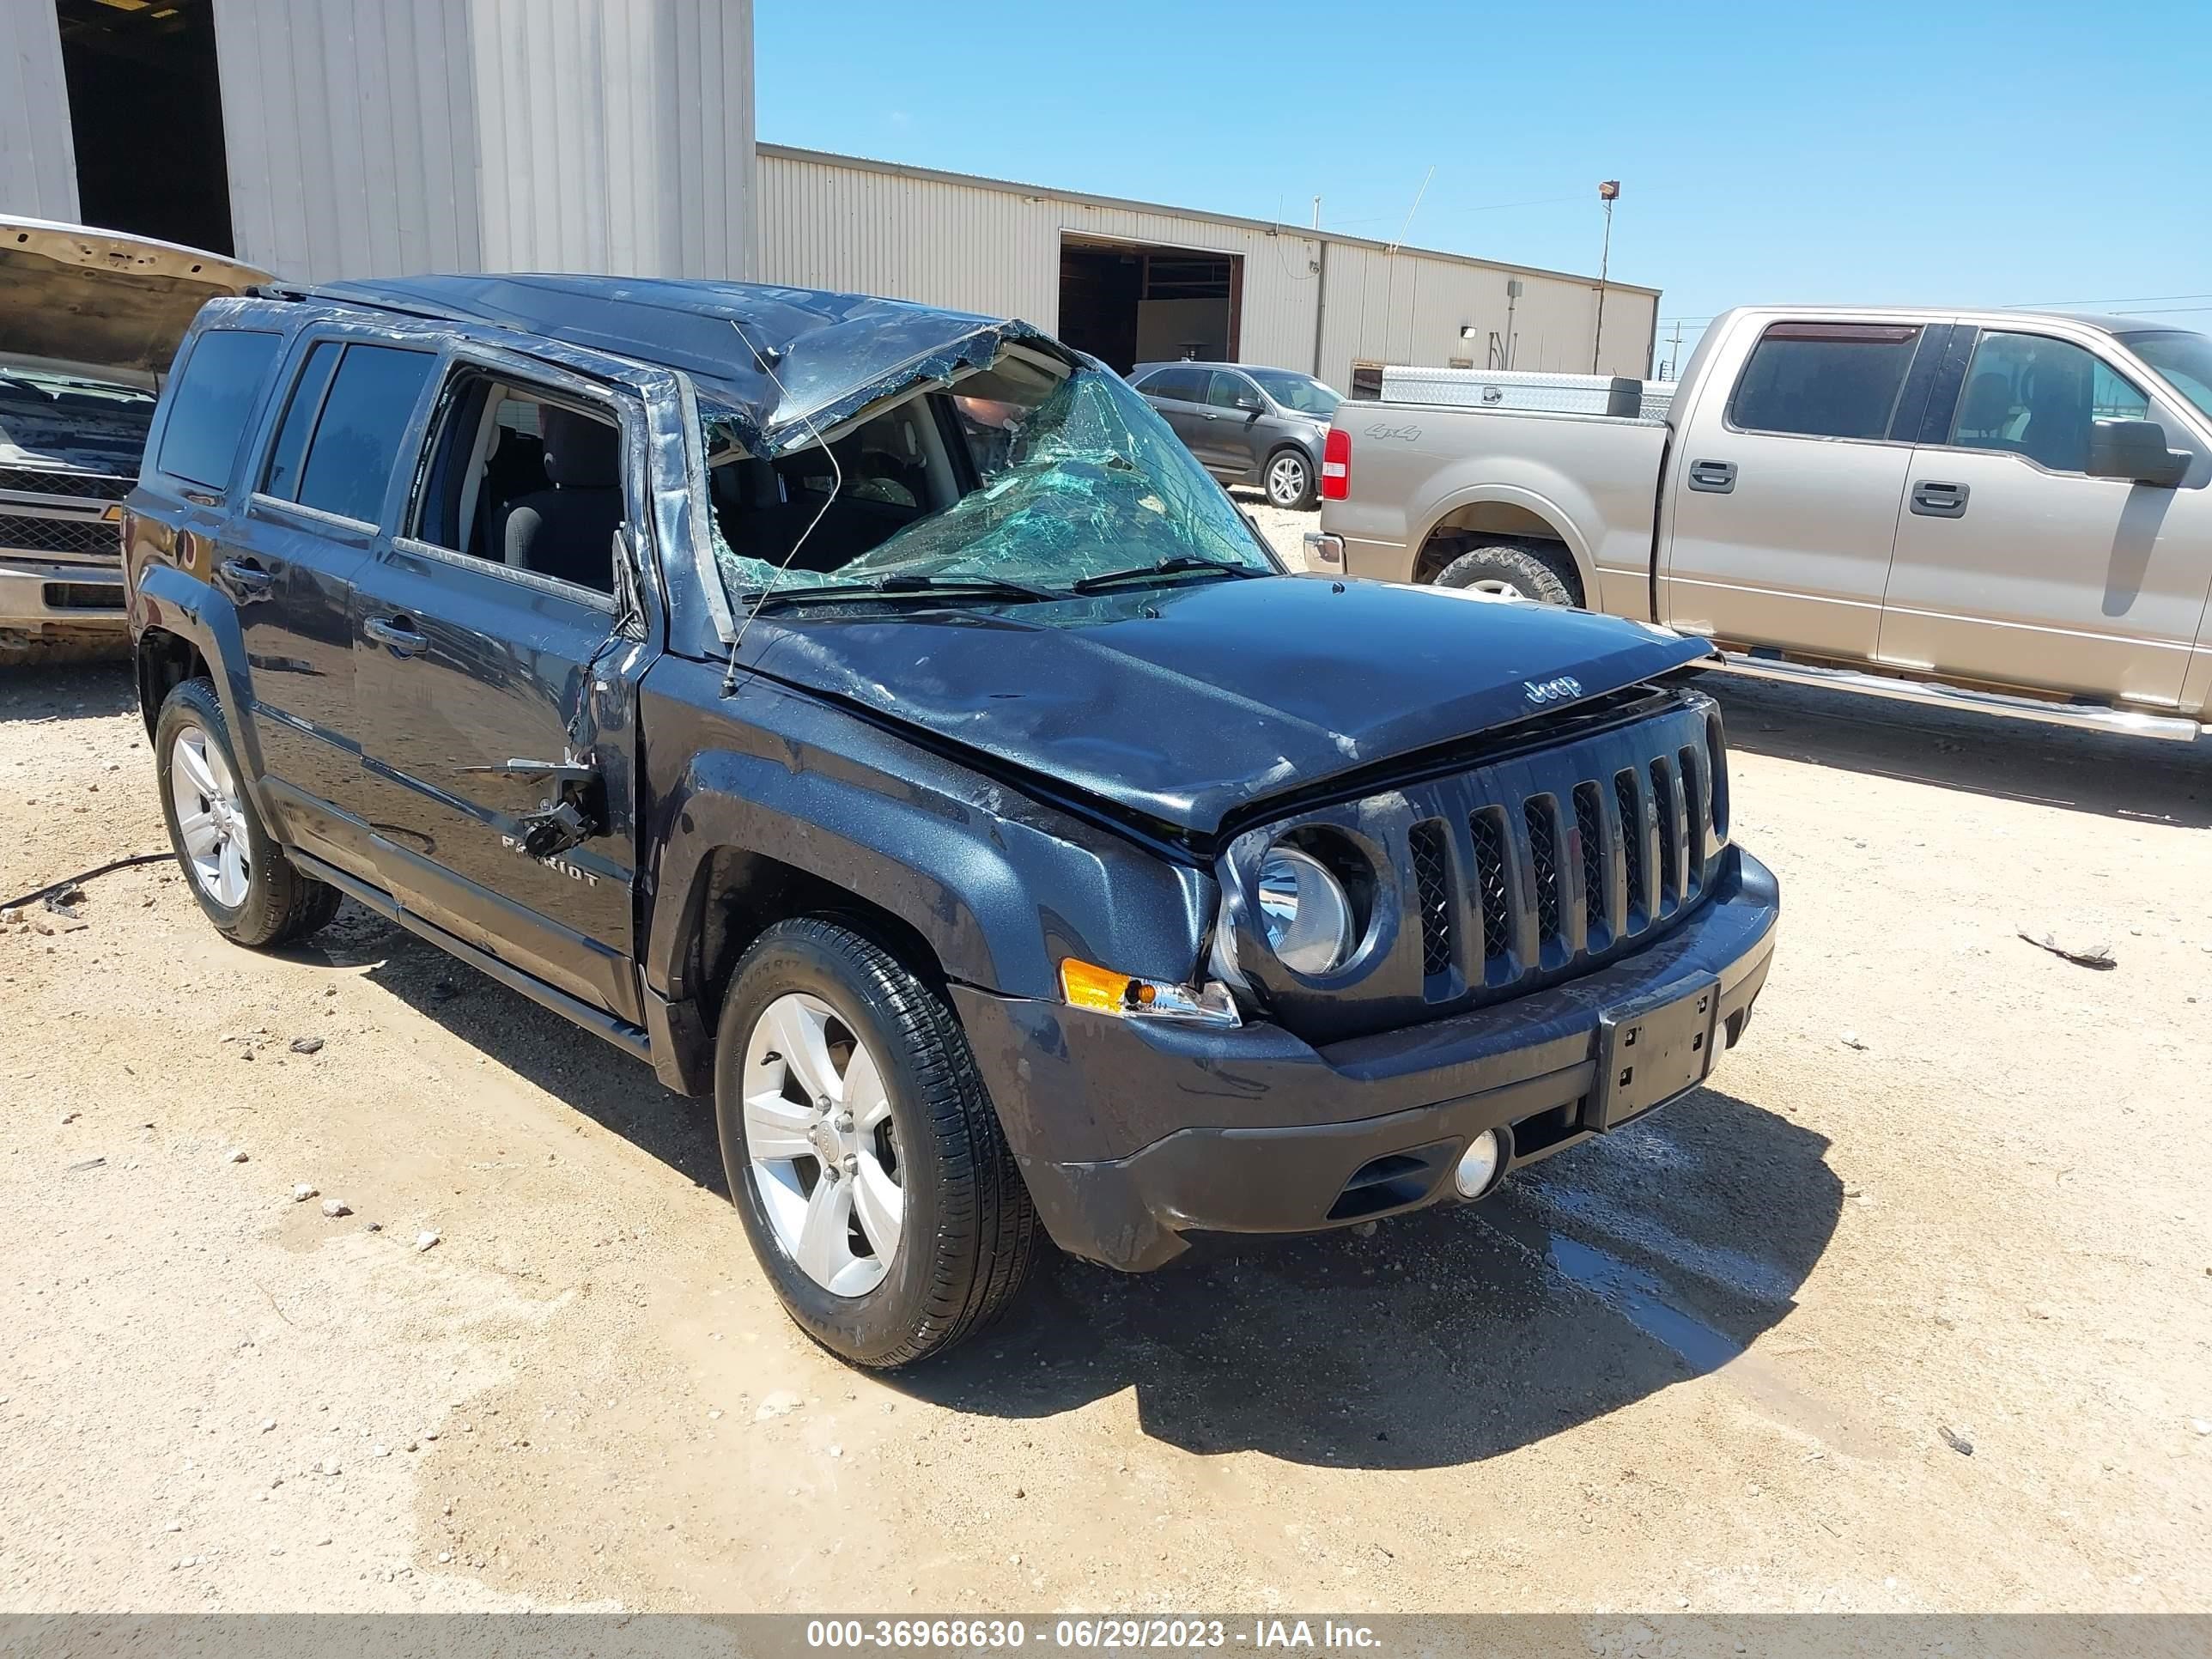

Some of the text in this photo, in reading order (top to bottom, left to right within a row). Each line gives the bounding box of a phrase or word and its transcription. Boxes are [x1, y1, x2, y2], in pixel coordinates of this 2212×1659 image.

[1364, 422, 1423, 441] 4x4
[1522, 676, 1582, 704] Jeep
[501, 835, 601, 887] PARIOT
